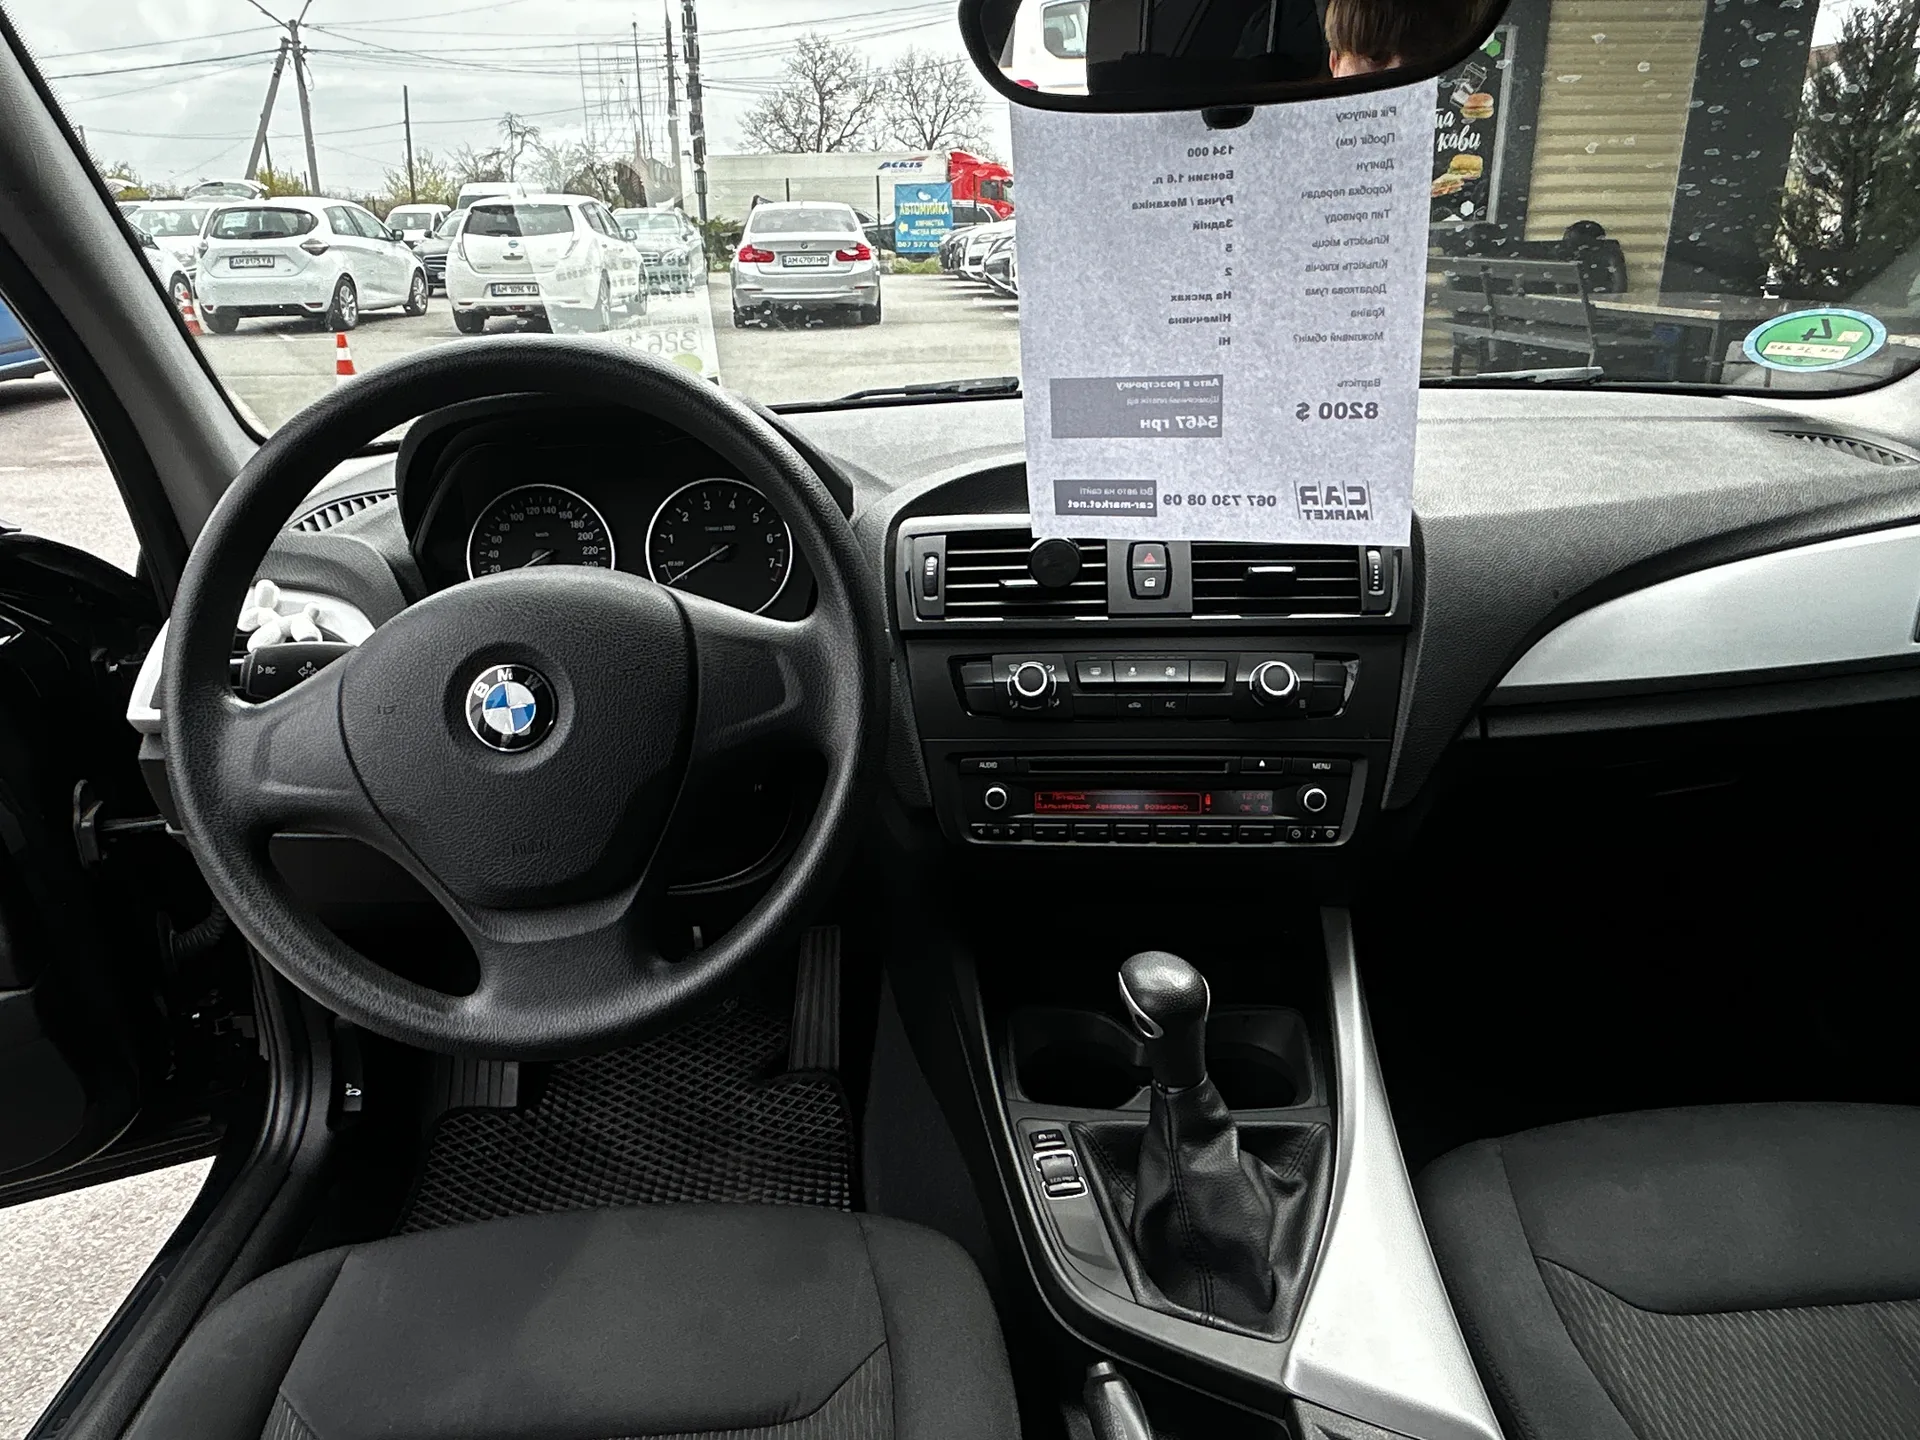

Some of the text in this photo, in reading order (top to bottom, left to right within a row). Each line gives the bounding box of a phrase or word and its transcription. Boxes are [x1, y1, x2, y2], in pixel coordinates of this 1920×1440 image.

[1437, 125, 1481, 152] кави
[703, 500, 711, 511] 3
[728, 499, 736, 510] 4
[525, 506, 540, 515] 120
[542, 506, 556, 515] 140
[510, 512, 524, 521] 100
[681, 511, 689, 522] 2
[752, 512, 760, 524] 5
[499, 522, 510, 532] 80
[569, 520, 585, 529] 180
[491, 535, 502, 544] 60
[577, 532, 593, 541] 200
[668, 533, 674, 544] 1
[766, 533, 774, 544] 6
[488, 549, 499, 558] 40
[582, 546, 598, 555] 220
[768, 557, 775, 568] 7
[489, 564, 501, 573] 20
